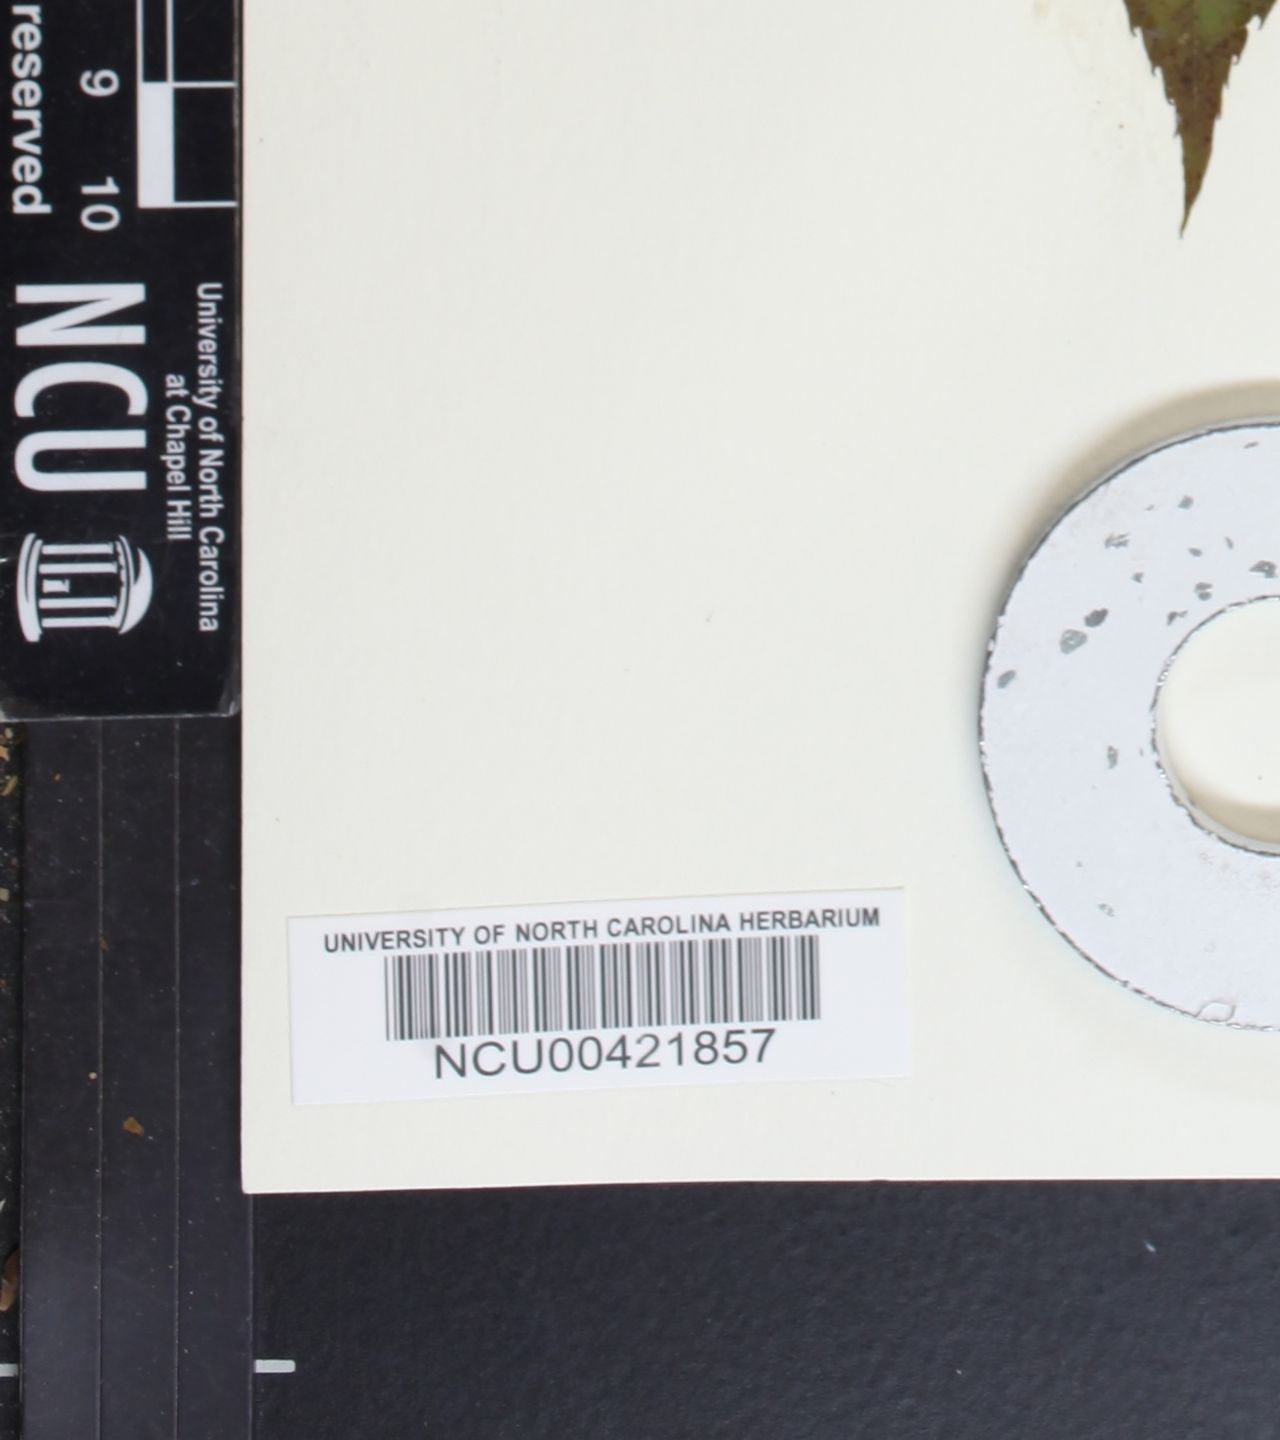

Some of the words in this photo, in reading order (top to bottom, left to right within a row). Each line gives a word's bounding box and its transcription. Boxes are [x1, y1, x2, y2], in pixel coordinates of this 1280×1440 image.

[11, 4, 52, 215] reserved
[79, 69, 120, 97] 9
[80, 176, 121, 232] 10
[192, 282, 223, 409] University
[14, 283, 149, 492] NCU
[165, 374, 190, 398] at
[160, 405, 192, 491] Chapel
[198, 416, 225, 442] of
[198, 449, 224, 518] North
[167, 500, 192, 540] Hill
[199, 526, 225, 632] Carolina
[324, 926, 465, 954] UNIVERSITY
[473, 924, 505, 945] OF
[515, 919, 598, 943] NORTH
[606, 913, 732, 938] CAROLINA
[739, 907, 880, 931] HERBARIUM
[433, 1027, 776, 1079] NCU00421857
